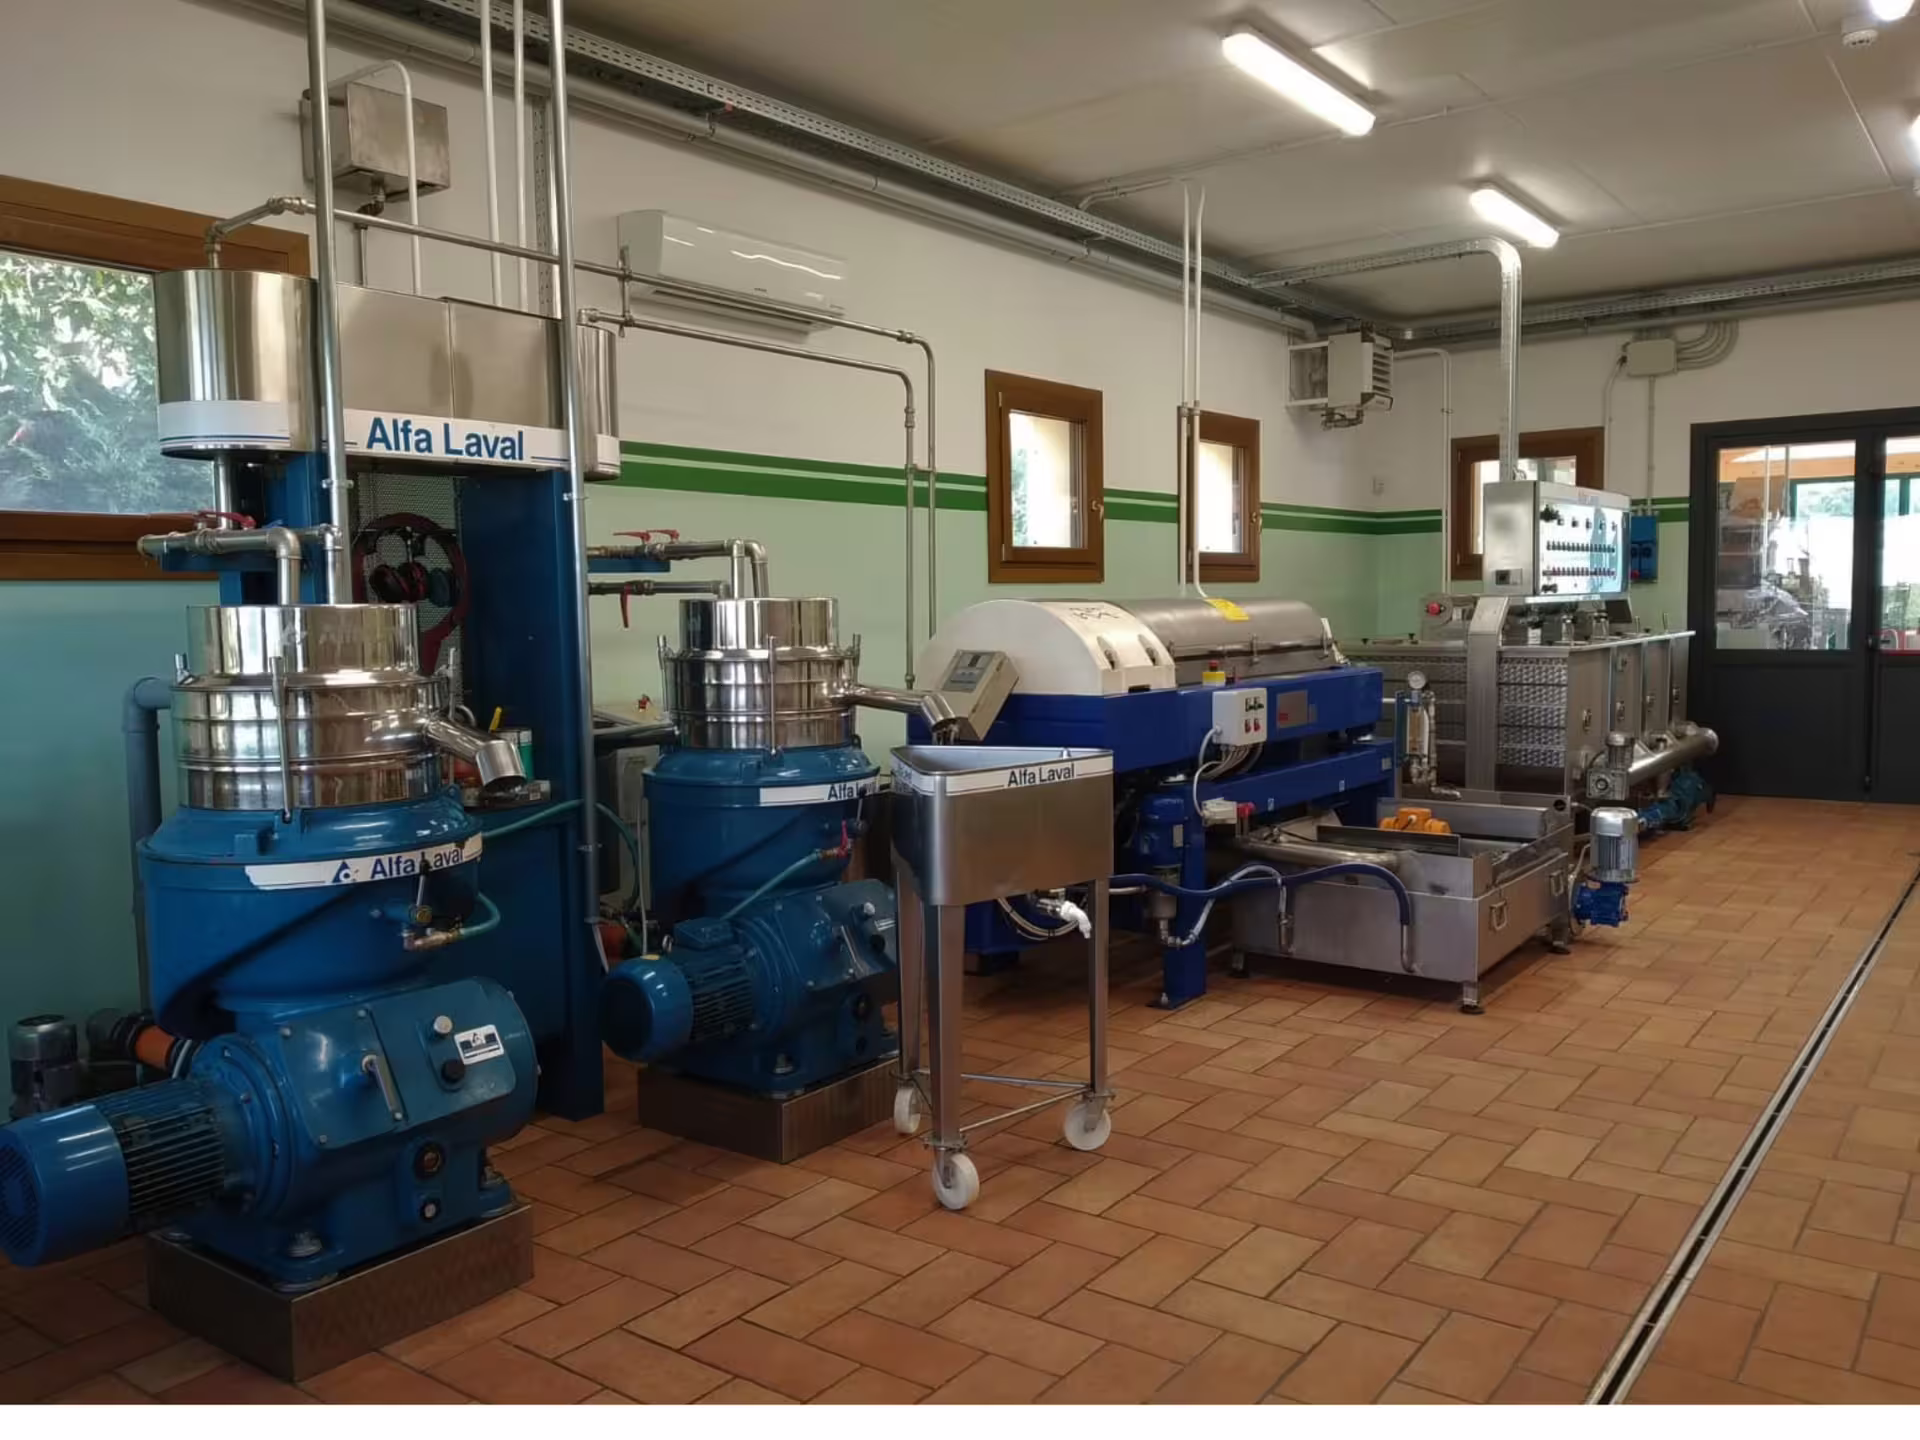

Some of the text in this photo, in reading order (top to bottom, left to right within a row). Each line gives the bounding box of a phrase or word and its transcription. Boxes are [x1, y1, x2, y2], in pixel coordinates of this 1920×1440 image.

[366, 417, 524, 461] Alfa Laval
[1008, 762, 1075, 787] Alfa Laval
[827, 783, 854, 800] Alfa
[370, 856, 415, 879] Alfa
